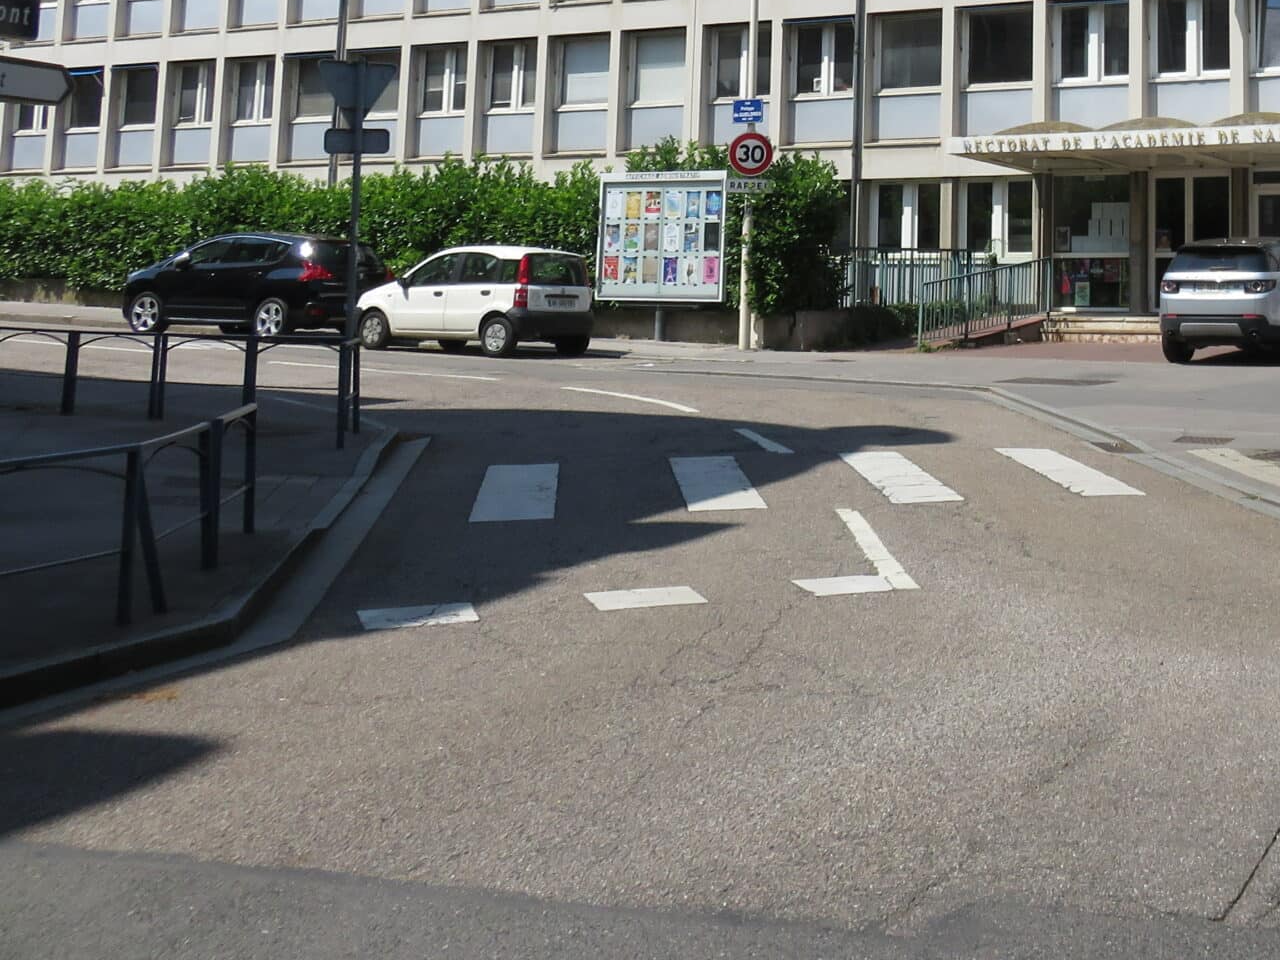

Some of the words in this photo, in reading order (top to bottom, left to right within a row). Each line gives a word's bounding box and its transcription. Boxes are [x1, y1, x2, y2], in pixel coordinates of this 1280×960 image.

[964, 138, 1050, 154] RECTORAT
[1062, 137, 1082, 151] DE
[1217, 129, 1240, 145] DE
[738, 144, 765, 164] 30
